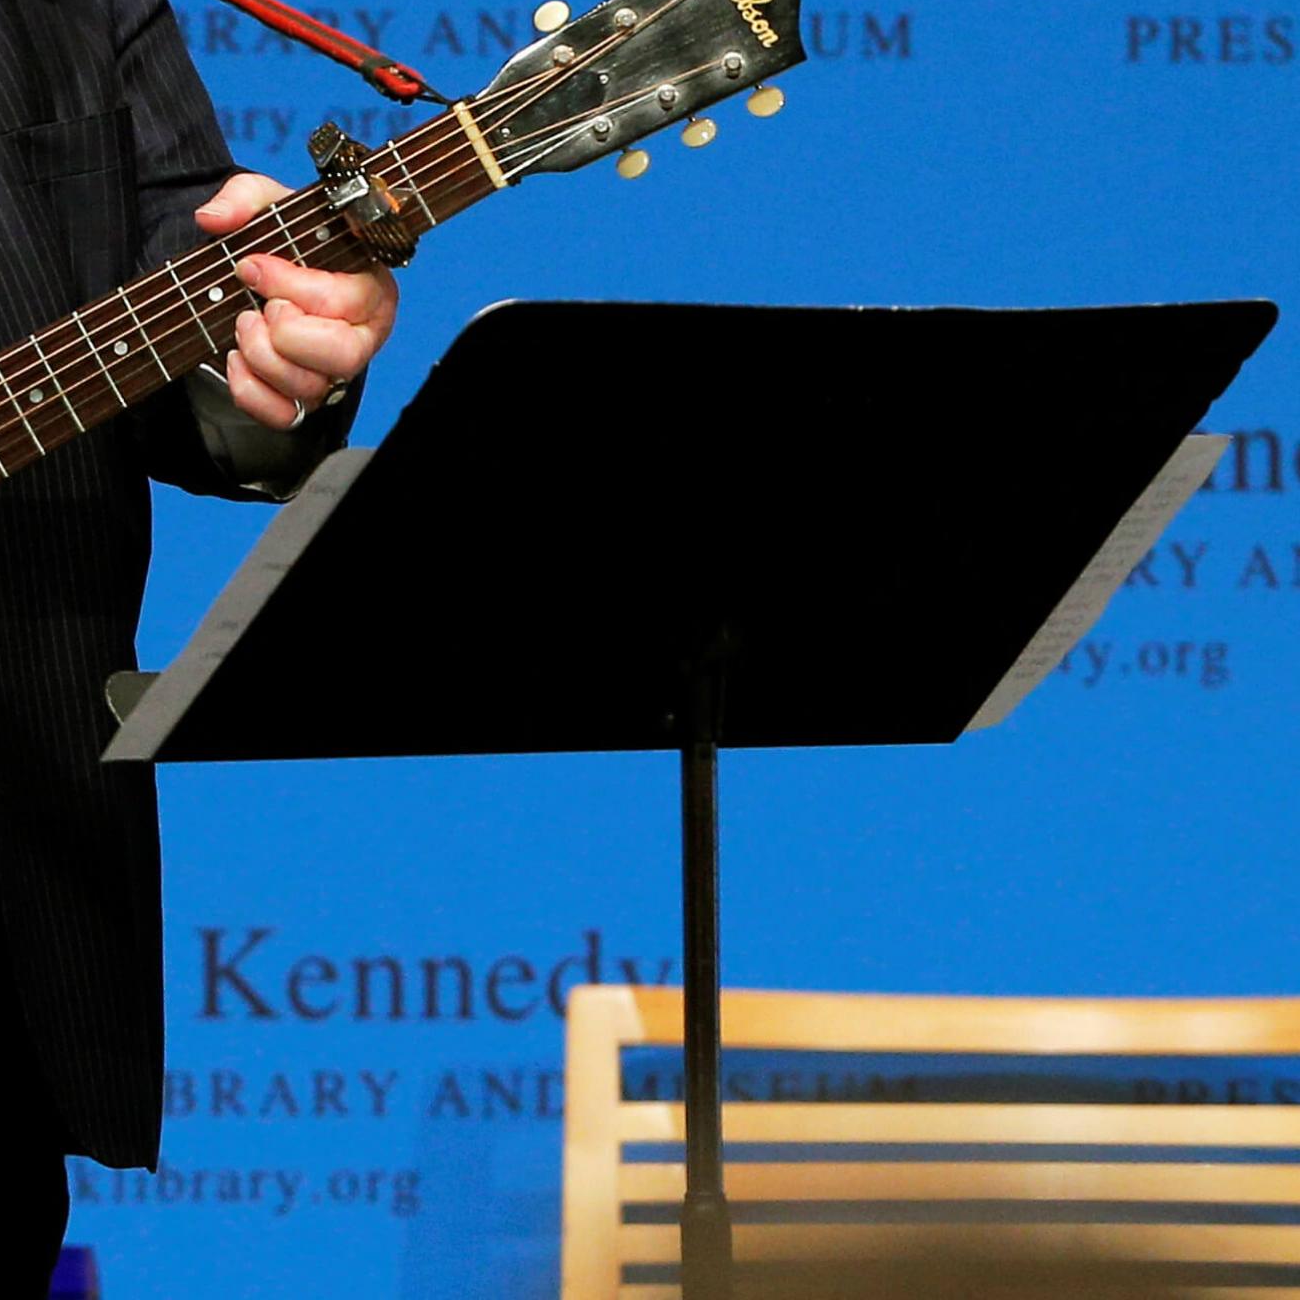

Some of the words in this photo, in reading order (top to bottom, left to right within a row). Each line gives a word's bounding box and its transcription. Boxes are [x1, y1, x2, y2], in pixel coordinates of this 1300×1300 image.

[422, 9, 532, 56] AN
[809, 11, 913, 60] UM
[1125, 15, 1297, 64] PRES
[1238, 541, 1300, 590] A
[197, 926, 676, 1021] Kenned
